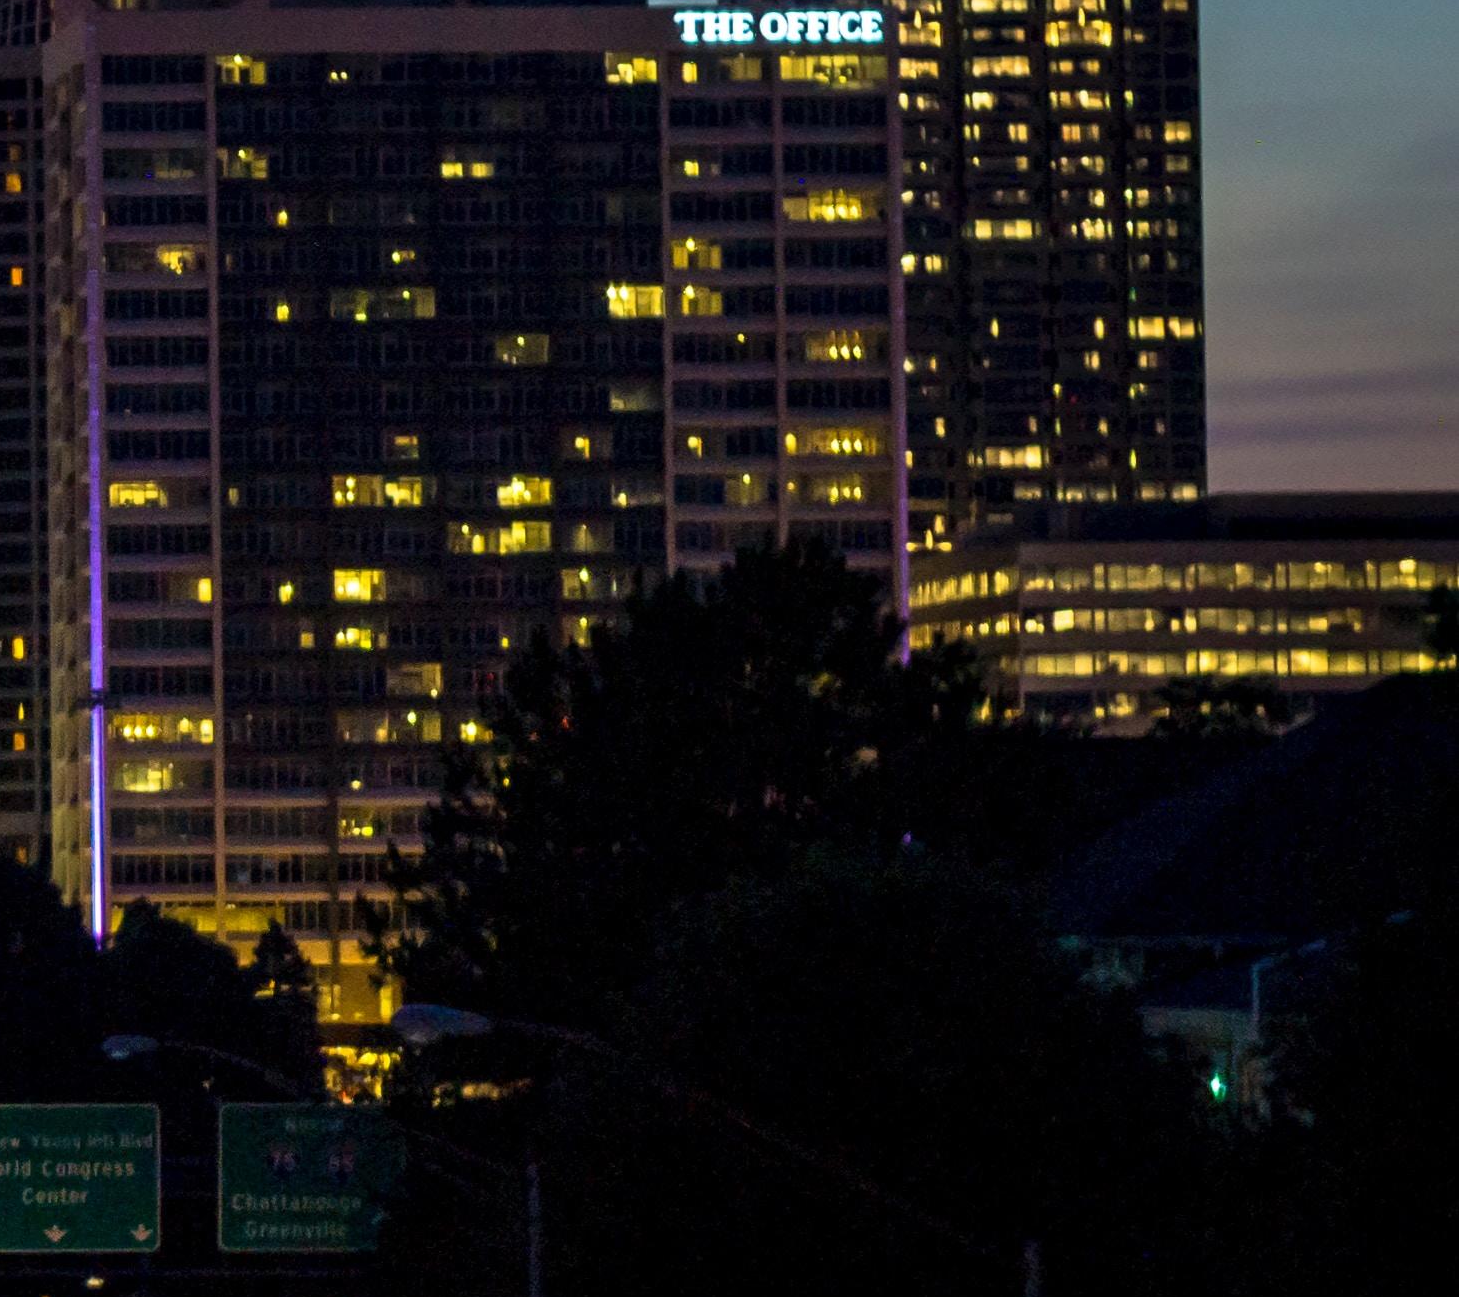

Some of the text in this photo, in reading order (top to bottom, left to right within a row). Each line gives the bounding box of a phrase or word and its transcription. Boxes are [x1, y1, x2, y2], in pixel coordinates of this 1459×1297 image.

[674, 10, 883, 43] THE OFFICE
[41, 1159, 135, 1181] Congress
[22, 1187, 90, 1205] Center
